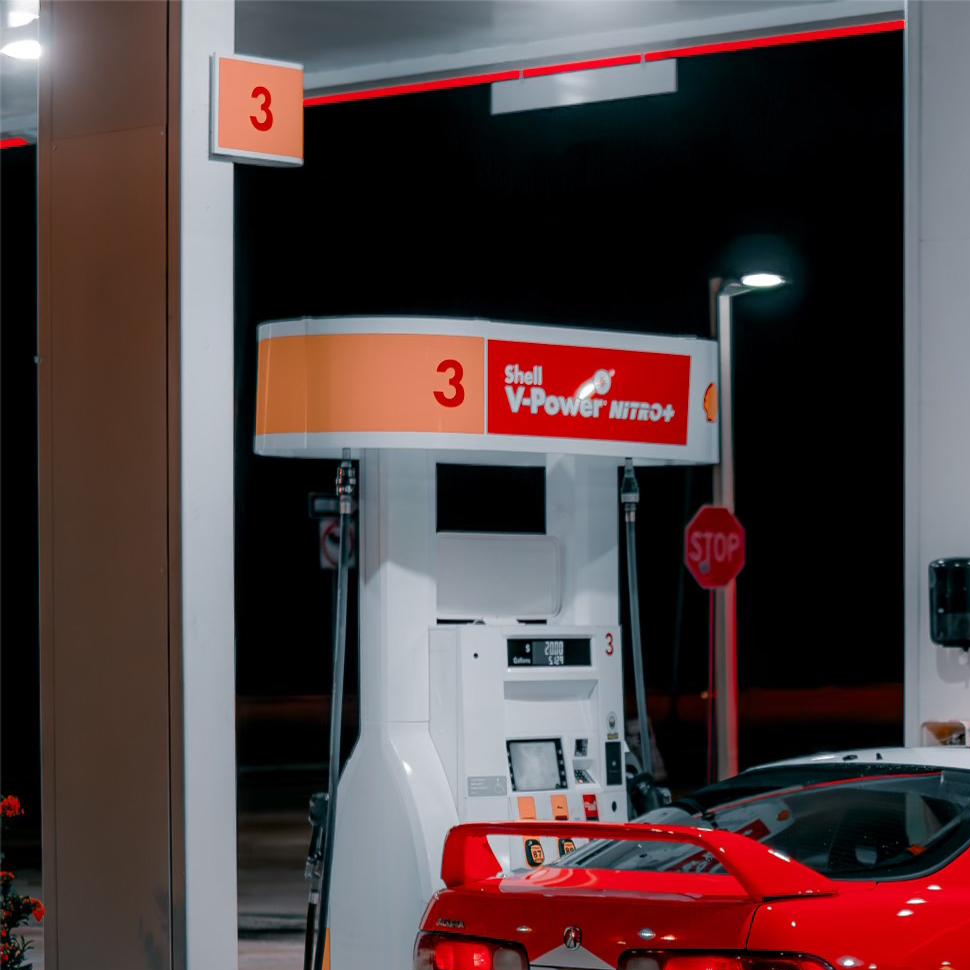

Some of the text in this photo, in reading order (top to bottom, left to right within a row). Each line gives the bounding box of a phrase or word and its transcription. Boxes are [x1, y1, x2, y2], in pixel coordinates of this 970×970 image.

[249, 86, 273, 132] 3
[433, 359, 465, 408] 3
[504, 364, 543, 386] Shell
[689, 531, 740, 563] STOP
[605, 632, 614, 656] 3
